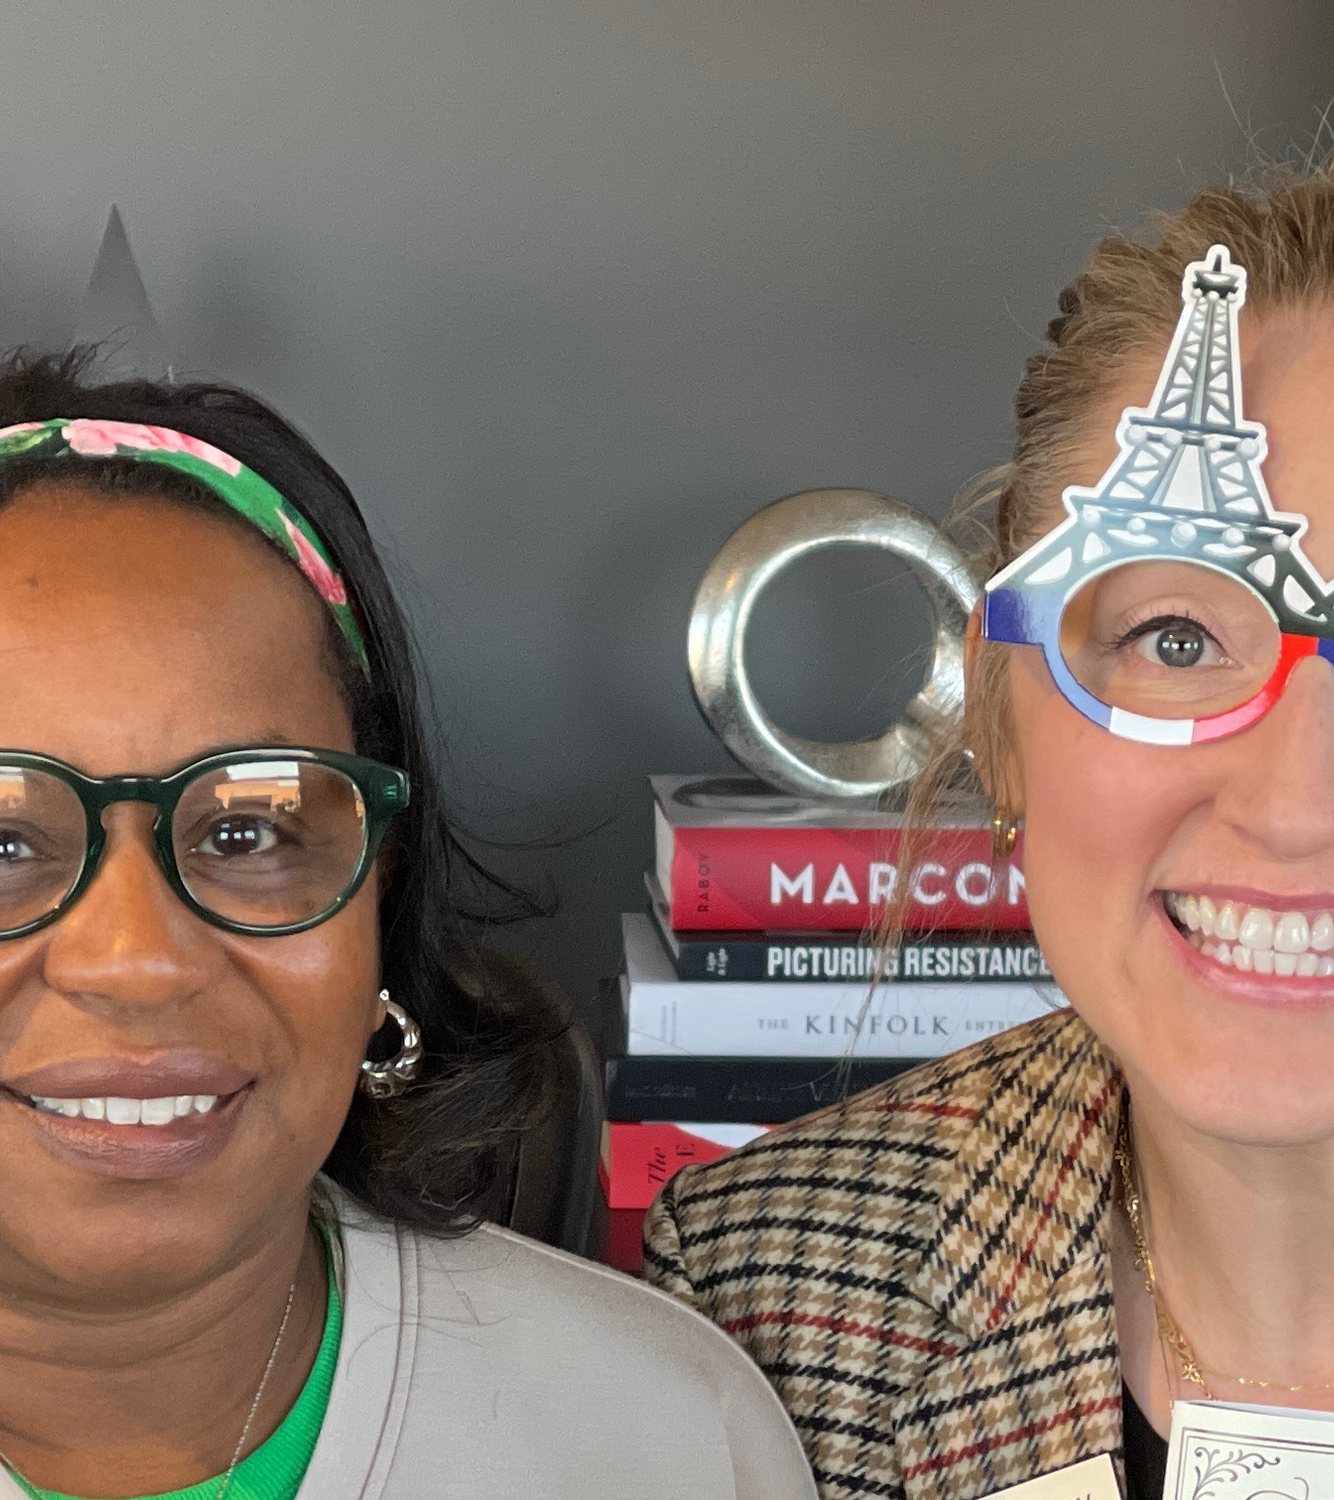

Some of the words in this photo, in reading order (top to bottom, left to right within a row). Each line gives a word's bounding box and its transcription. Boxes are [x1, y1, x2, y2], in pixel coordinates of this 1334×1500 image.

[767, 946, 899, 977] PICTURING
[757, 1018, 789, 1030] THE
[805, 1014, 949, 1036] KINFOLK
